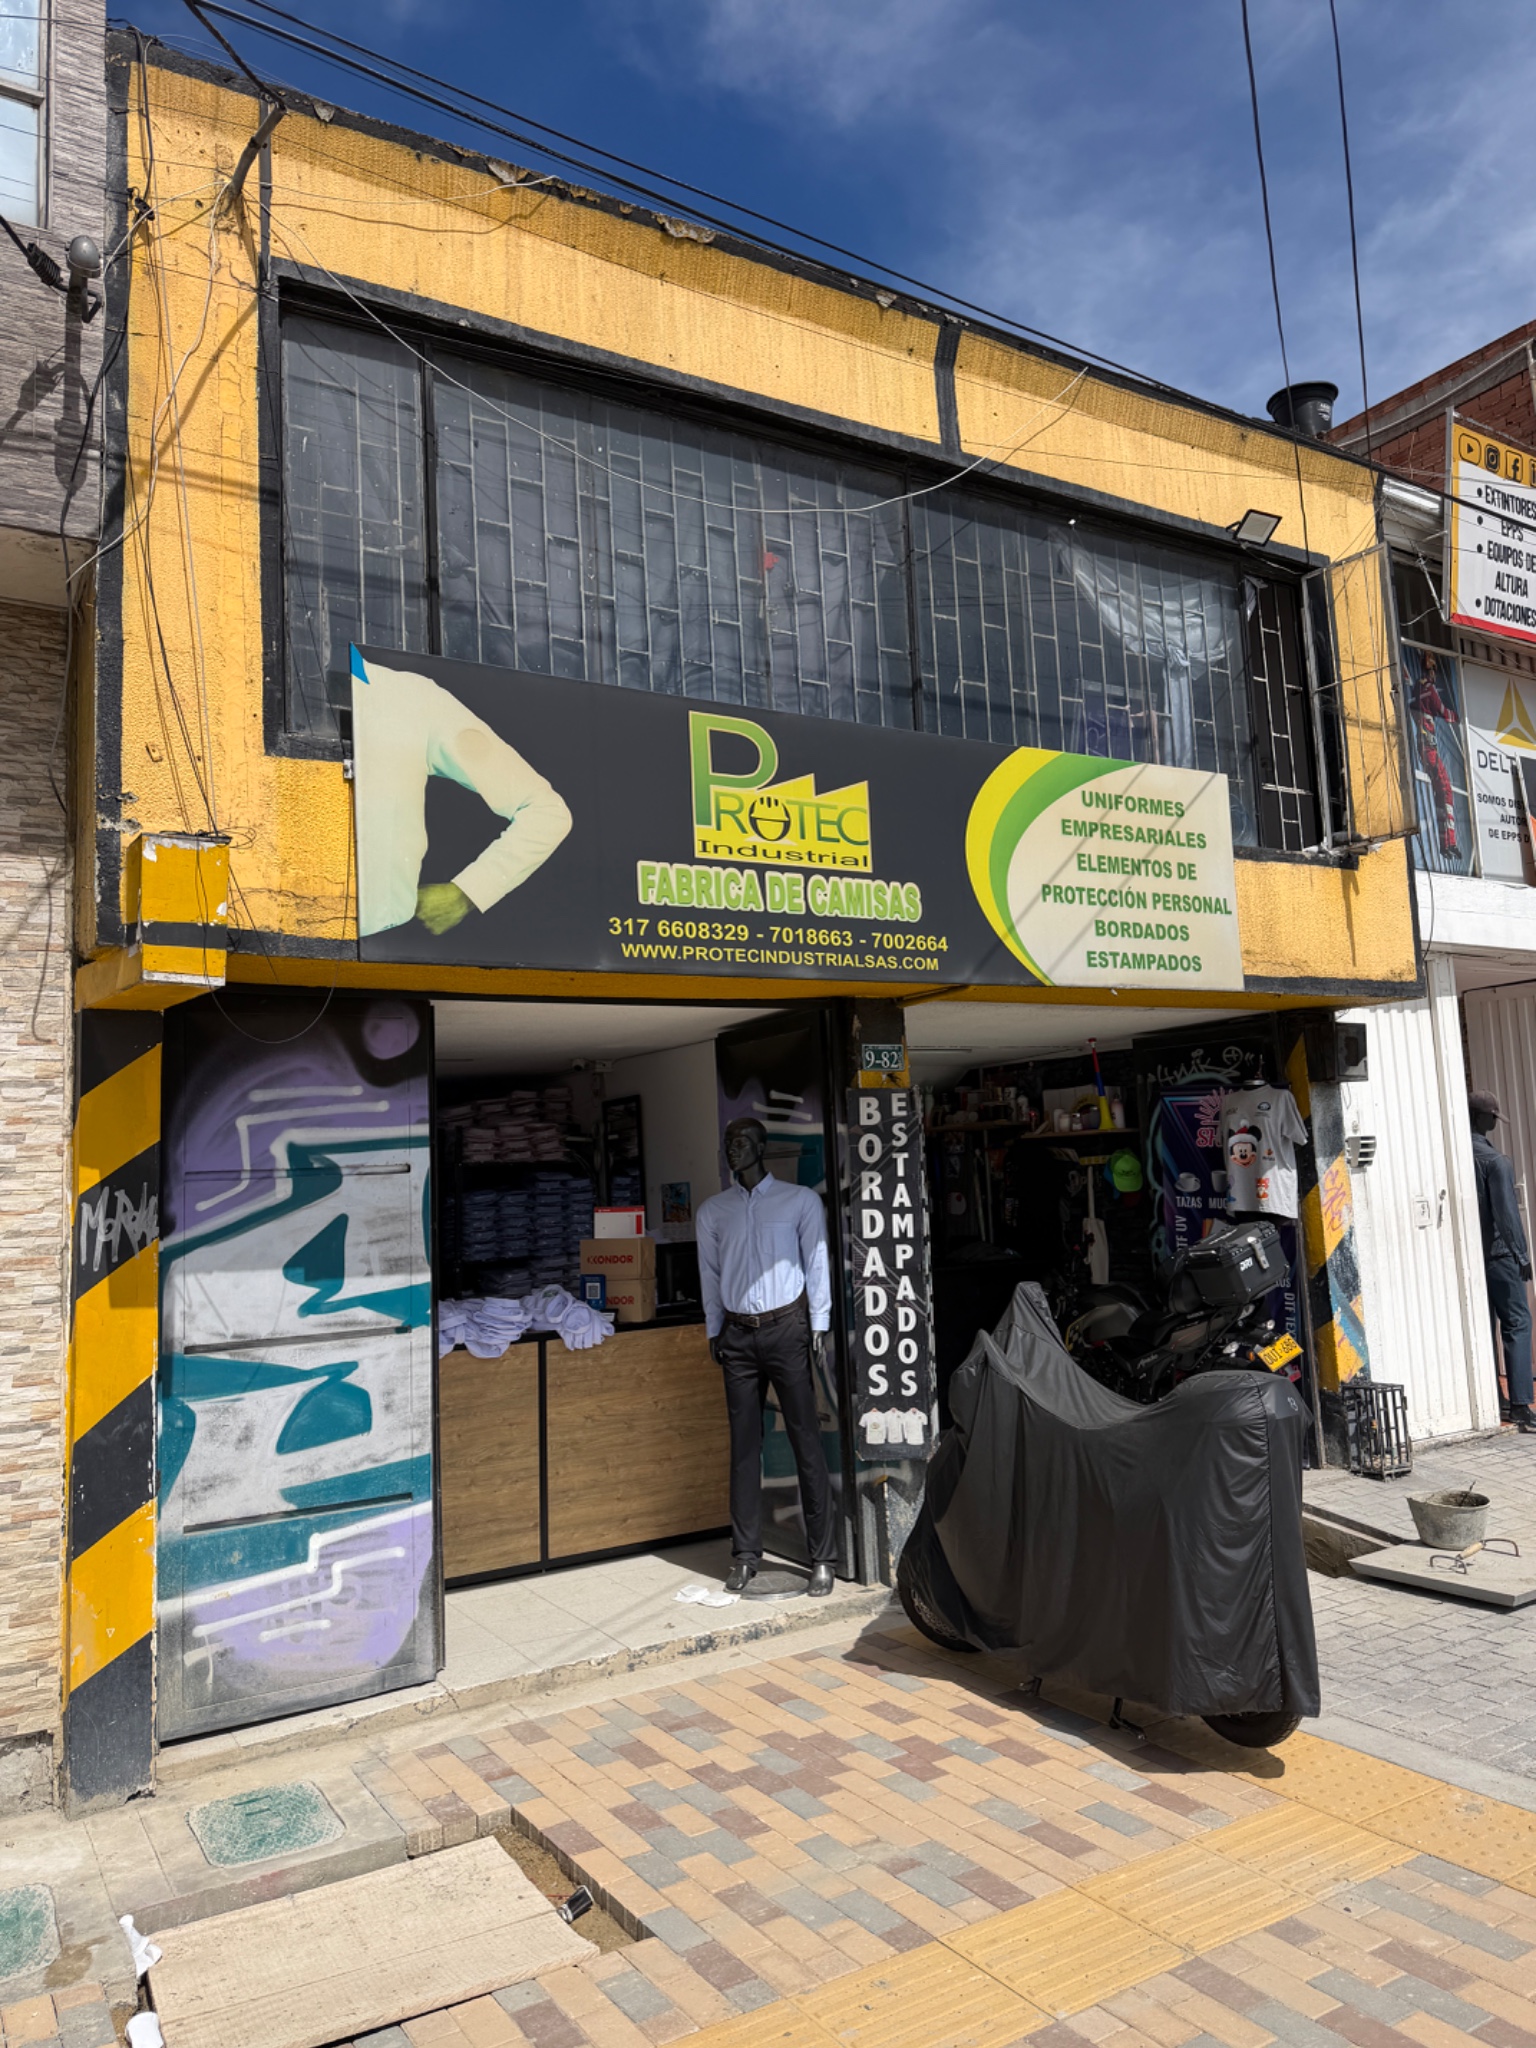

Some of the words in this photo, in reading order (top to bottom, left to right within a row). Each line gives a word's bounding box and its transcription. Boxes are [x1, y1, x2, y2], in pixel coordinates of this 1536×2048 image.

[1501, 519, 1523, 541] EPPS
[1487, 540, 1523, 569] EQUIPOS
[1525, 552, 1536, 574] DE
[1495, 571, 1528, 598] ALTURA
[1484, 595, 1536, 627] DOTACIONES
[1081, 790, 1185, 818] UNIFORMES
[1477, 793, 1507, 807] SOMOS
[1061, 818, 1207, 849] EMPRESARIALES
[1488, 828, 1500, 839] DE
[1502, 830, 1522, 842] EPPS
[698, 839, 868, 867] Industrial
[1077, 853, 1173, 879] ELEMENTOS
[1177, 863, 1197, 881] DE
[638, 861, 764, 911] FABRICA
[766, 871, 806, 915] DE
[807, 874, 922, 923] CAMISAS
[1041, 884, 1147, 910] PROTECCIÓN
[1152, 892, 1233, 915] PERSONAL
[608, 917, 650, 937] 317
[657, 919, 749, 942] 6608329
[769, 926, 853, 947] 7018663
[871, 932, 949, 952] 7002664
[1095, 919, 1190, 942] BORDADOS
[621, 943, 939, 971] WWW.PROTECINDUSTRIALSAS.COM
[1086, 950, 1203, 972] ESTAMPADOS
[865, 1050, 899, 1068] 9-82
[1175, 1196, 1203, 1209] TAZAS
[858, 1096, 890, 1397] BORDADOS
[891, 1093, 919, 1397] ESTAMPADOS
